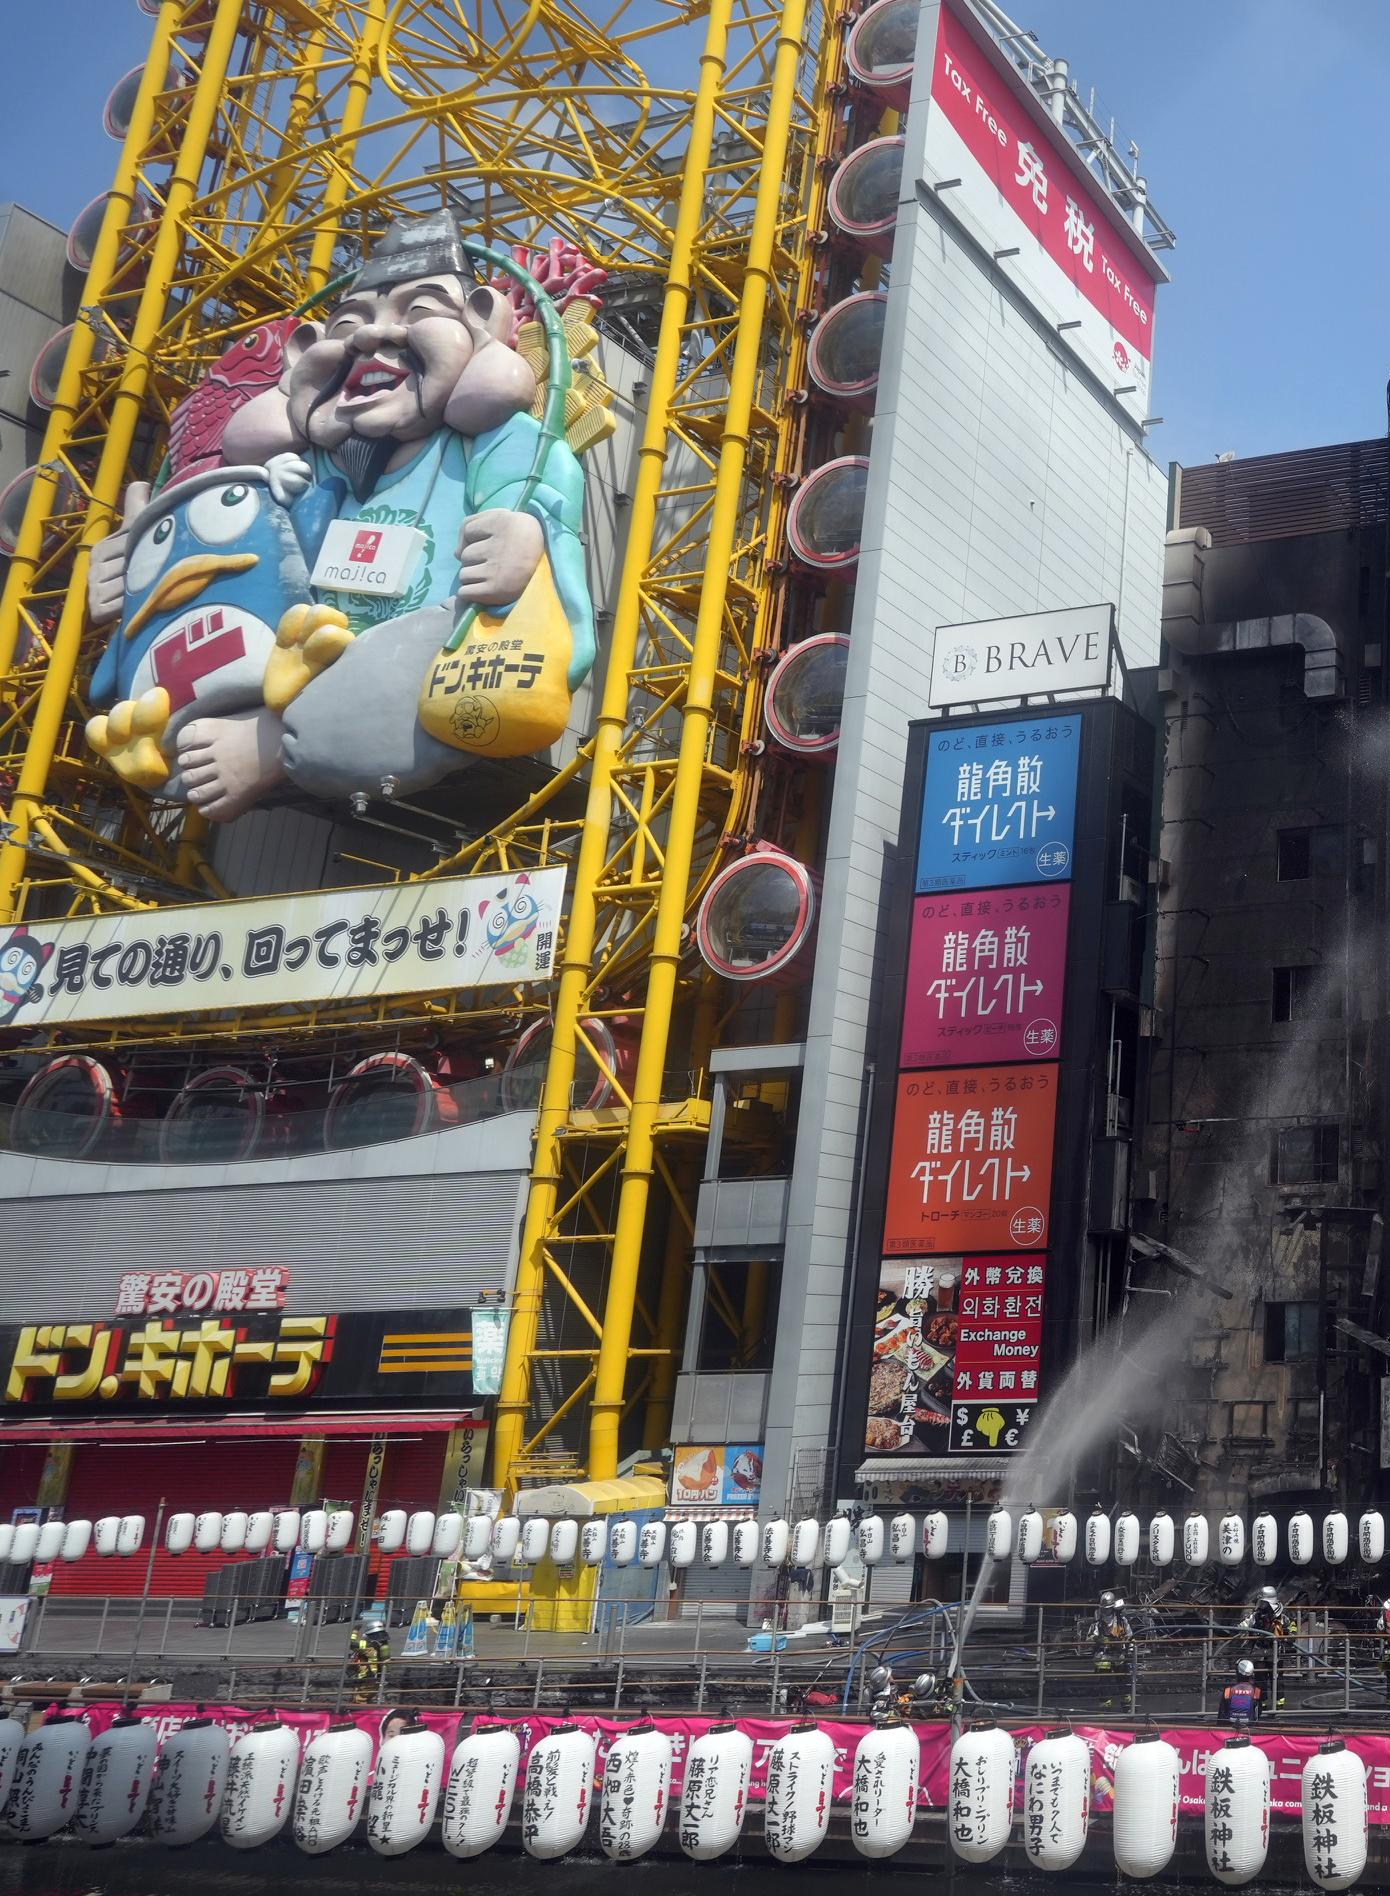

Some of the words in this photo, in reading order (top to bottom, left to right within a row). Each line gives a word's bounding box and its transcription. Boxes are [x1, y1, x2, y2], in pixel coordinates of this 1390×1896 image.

[944, 53, 971, 104] Tax
[976, 95, 1008, 147] Free
[1014, 141, 1095, 273] 免税
[1101, 256, 1122, 293] Tax
[1124, 285, 1148, 325] Free
[984, 631, 1100, 673] BRAVE
[957, 755, 1043, 802] 龍角散
[1038, 851, 1067, 867] 生薬
[535, 932, 552, 971] 開運
[942, 925, 1031, 973] 龍角散
[1026, 1028, 1054, 1045] 生薬
[927, 1106, 1018, 1154] 龍角散
[921, 1210, 960, 1223] トローチ
[1012, 1217, 1042, 1234] 生薬
[115, 1266, 288, 1315] 驚安の殿堂
[961, 1294, 1043, 1319] 외화환전
[960, 1328, 1026, 1344] Exchange
[993, 1343, 1040, 1358] Money
[957, 1370, 1038, 1391] 外貨両替
[523, 1751, 545, 1847] 高橋恭平
[601, 1752, 623, 1848] 西畑大吾
[853, 1754, 873, 1837] 大橋和也
[953, 1756, 973, 1843] 大橋和也
[1028, 1762, 1048, 1857] なにわ男子
[1210, 1767, 1236, 1873] 鉄板神社
[1311, 1771, 1341, 1880] 鉄板神社
